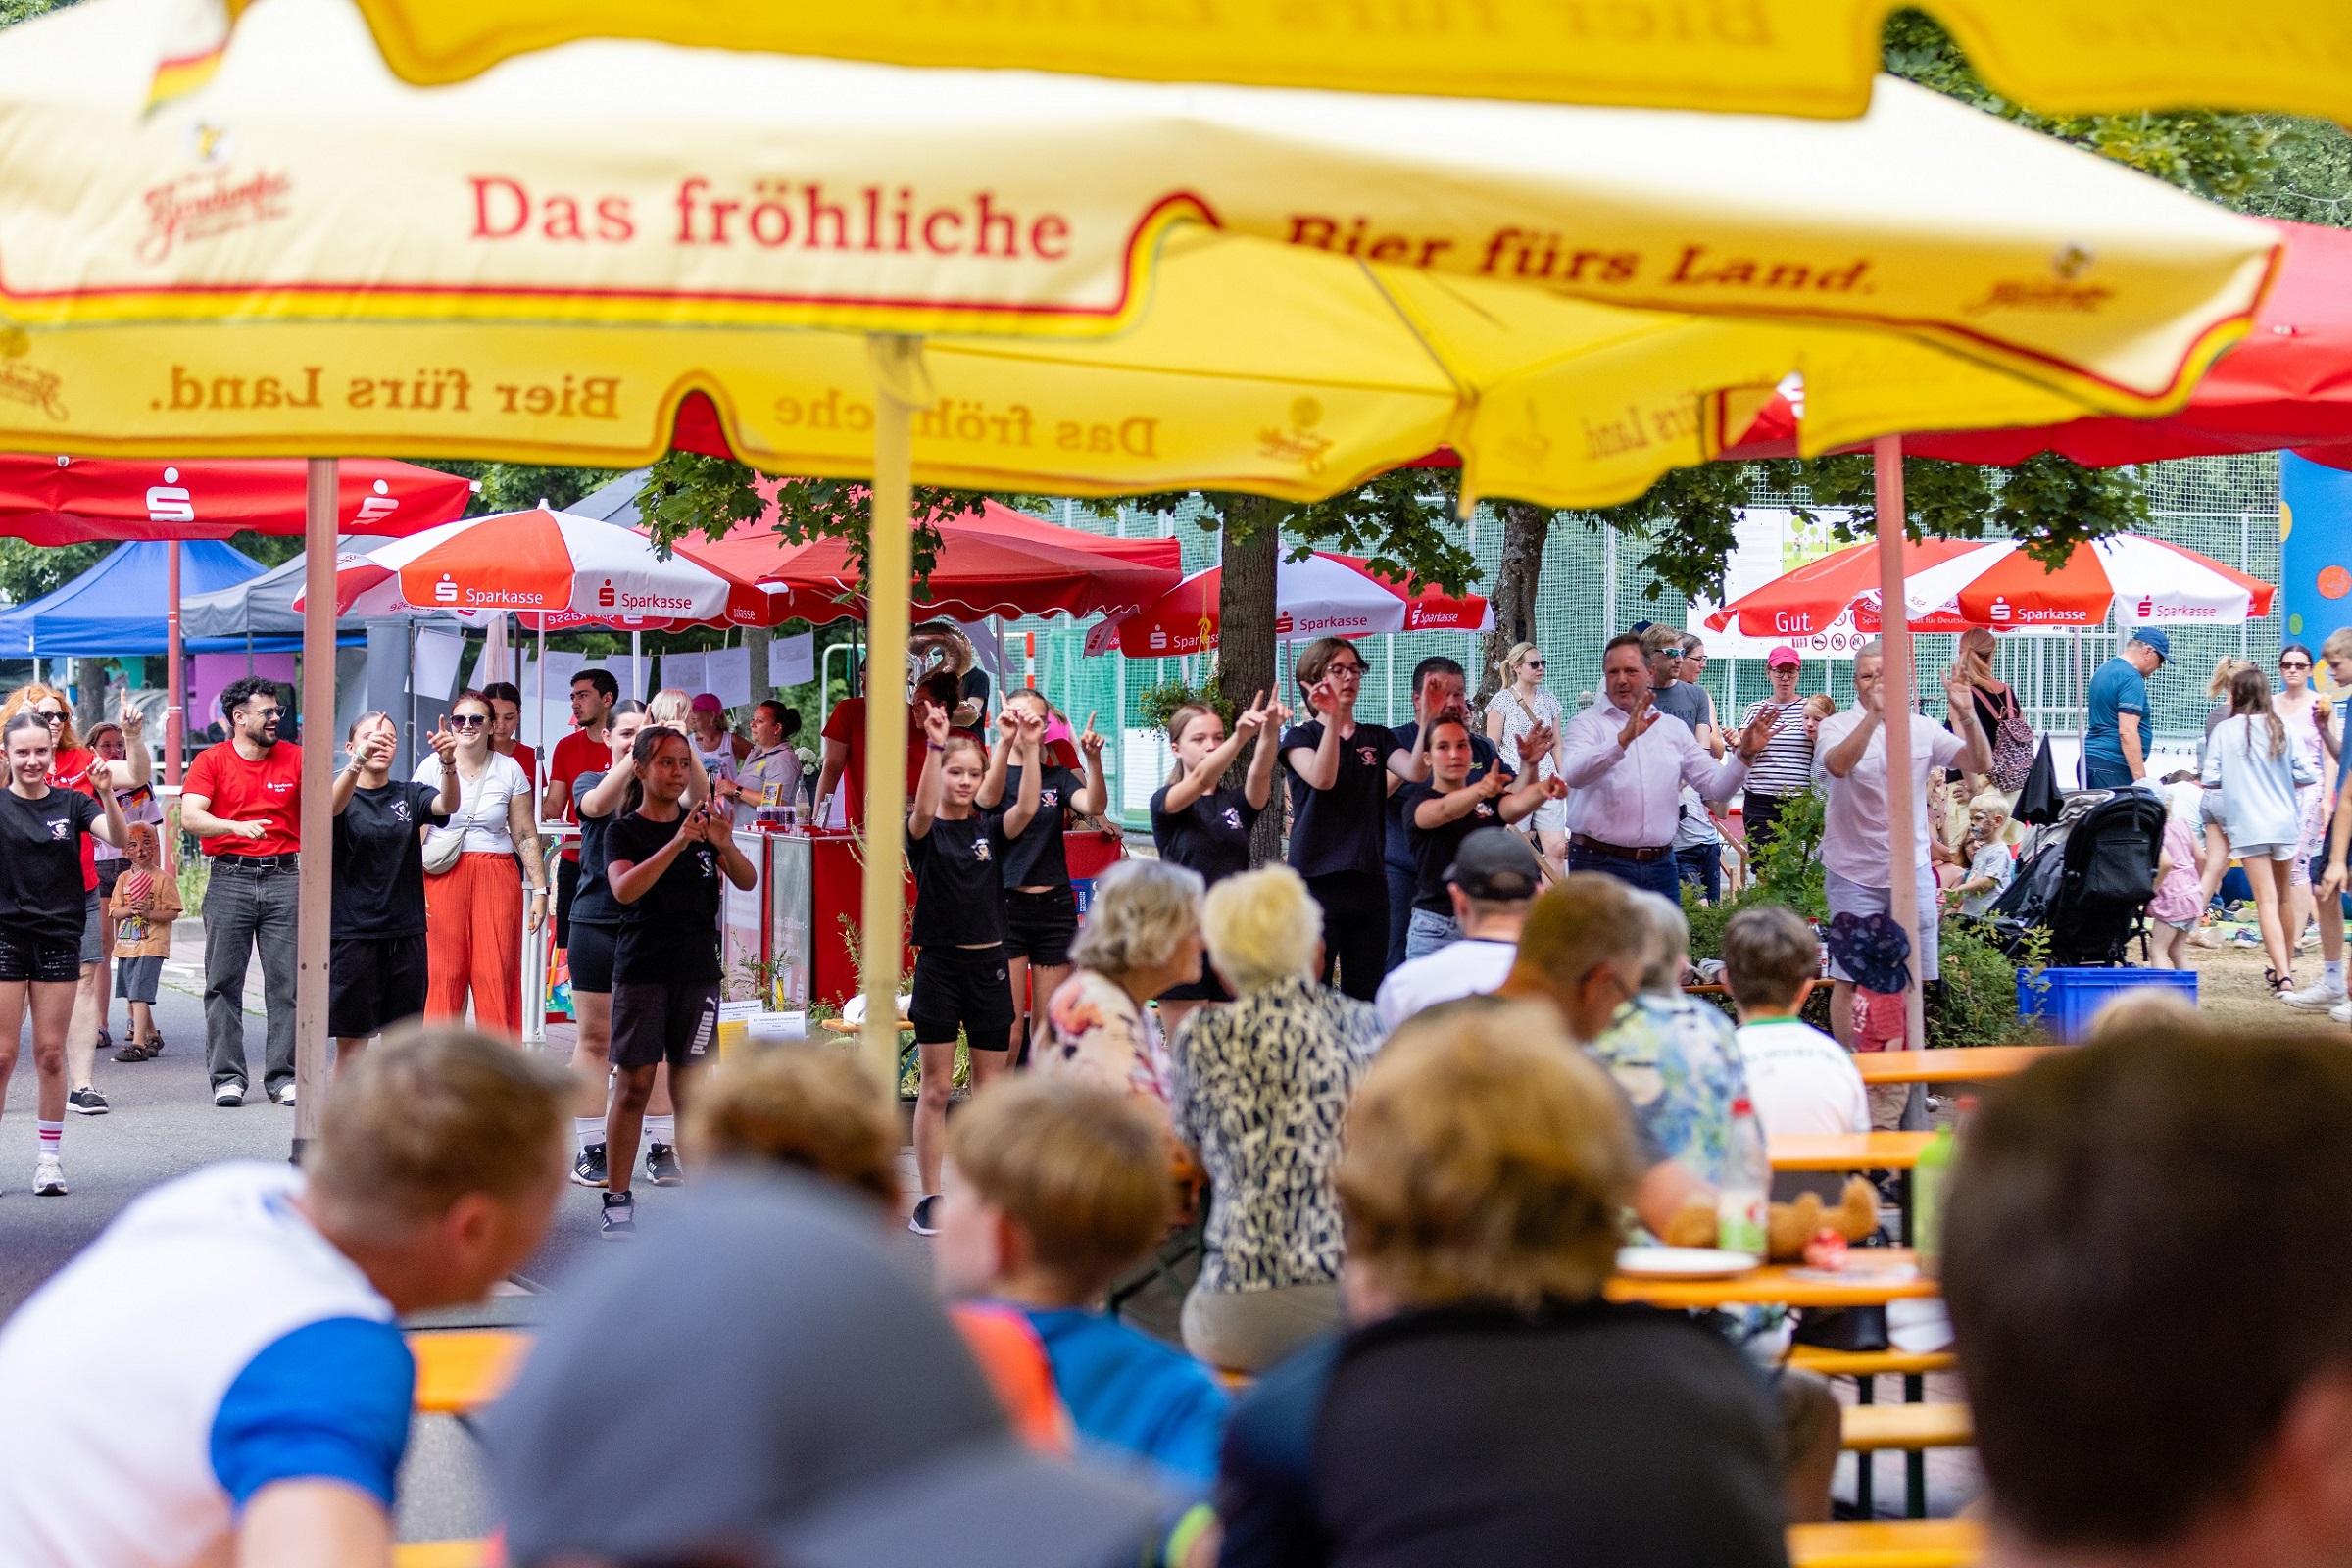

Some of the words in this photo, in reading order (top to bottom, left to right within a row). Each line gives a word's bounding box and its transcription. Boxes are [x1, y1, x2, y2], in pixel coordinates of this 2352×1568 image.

[469, 176, 635, 242] Das
[676, 178, 1070, 262] fröhliche
[1478, 225, 1641, 282] fürs
[1666, 244, 1878, 295] Land.
[466, 587, 544, 606] Sparkasse
[621, 594, 692, 610] Sparkasse
[1419, 611, 1459, 624] Sparkasse
[2017, 607, 2087, 622] Sparkasse
[2156, 604, 2217, 618] Sparkasse
[1299, 615, 1368, 631] Sparkasse
[1775, 611, 1814, 633] Gut.
